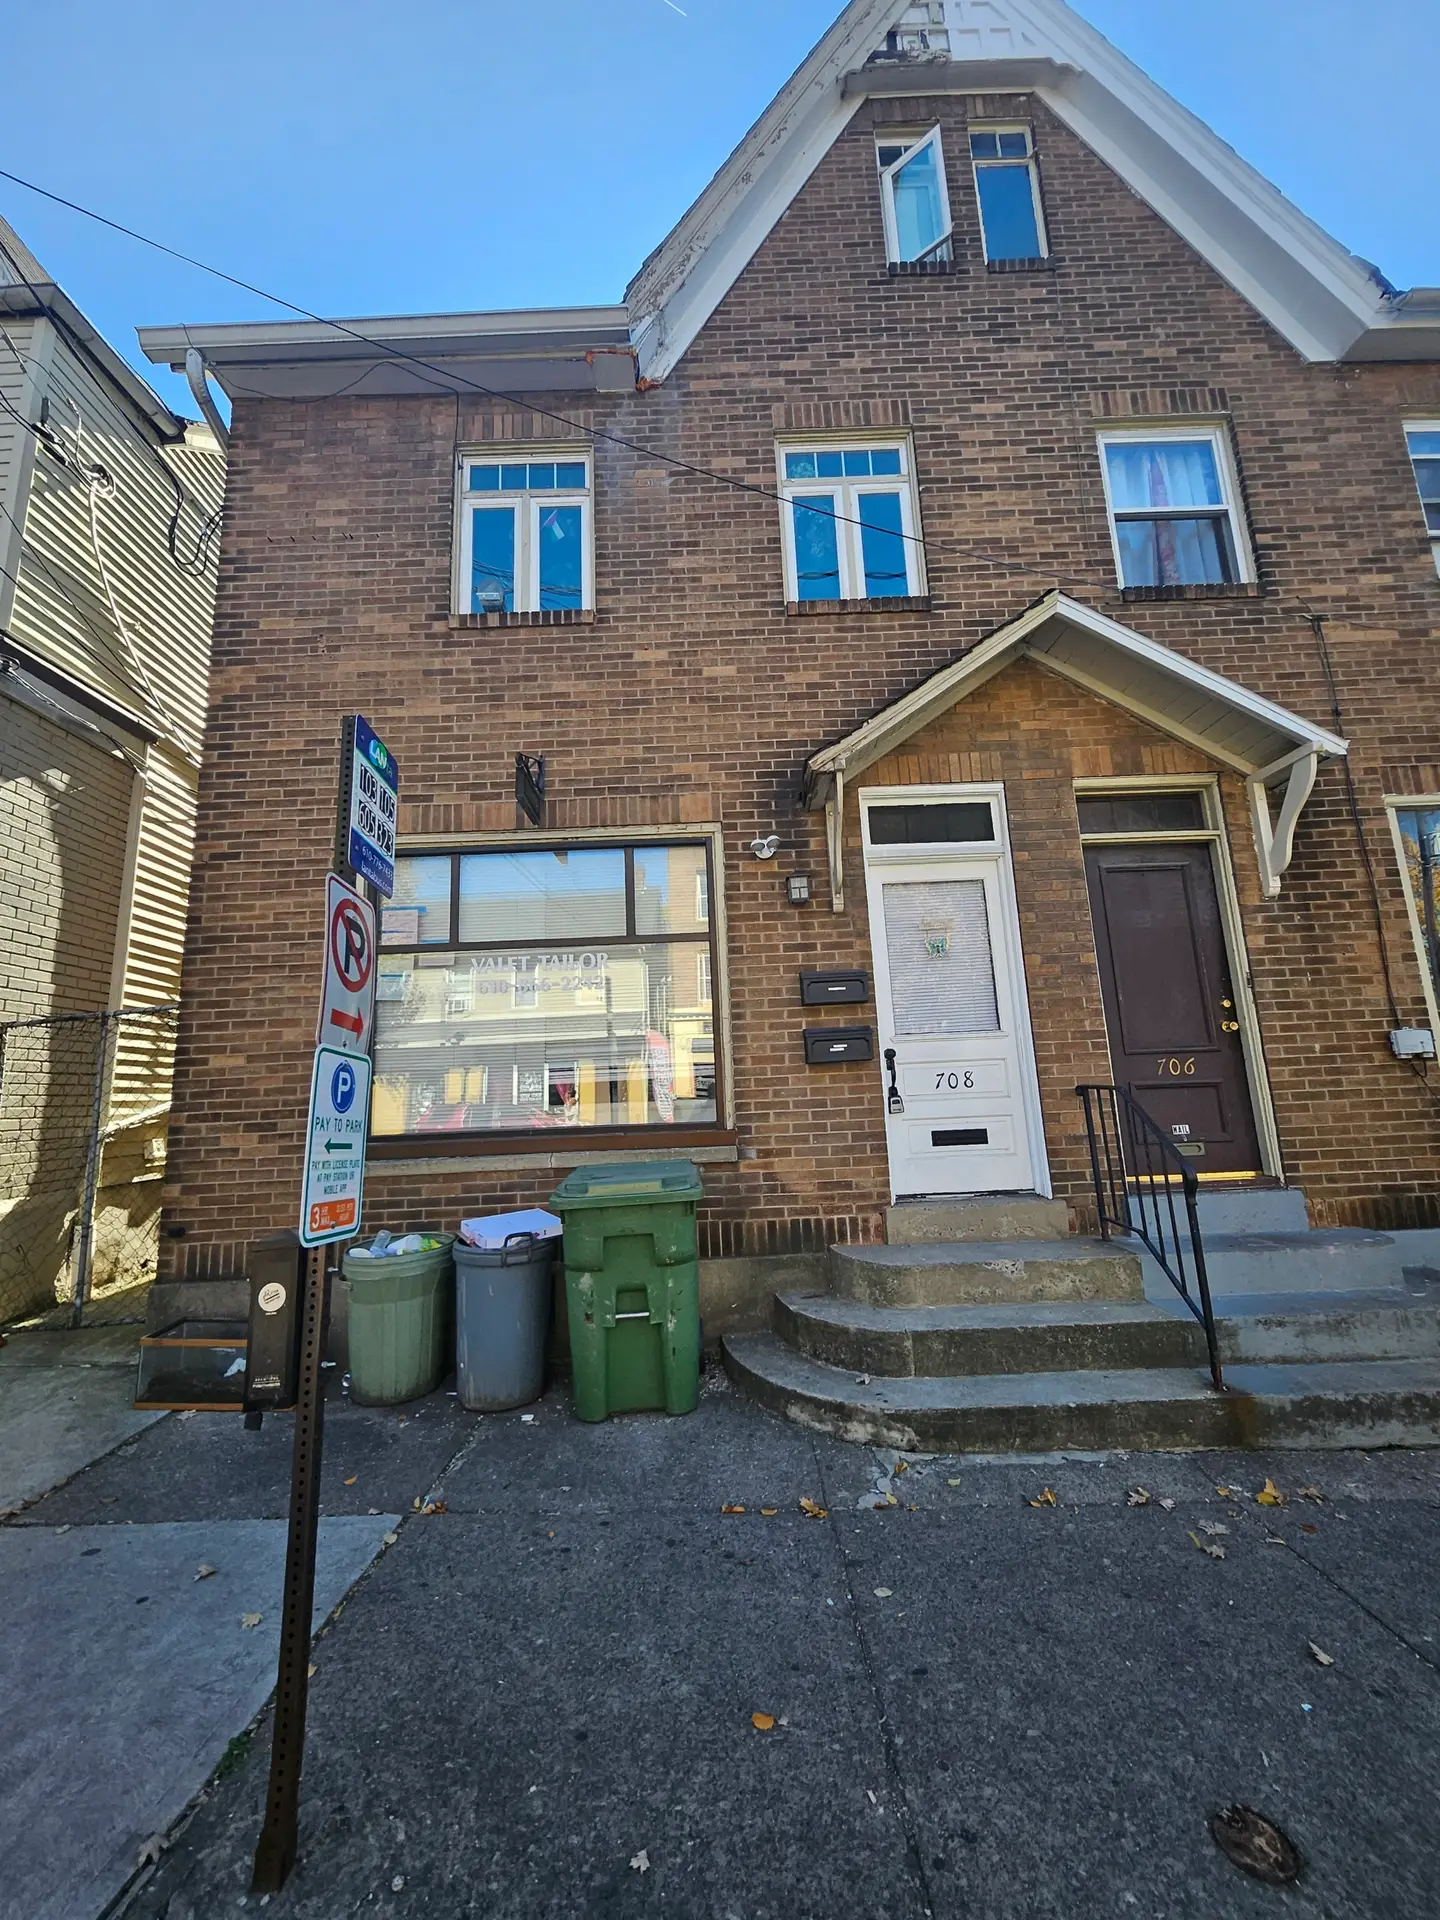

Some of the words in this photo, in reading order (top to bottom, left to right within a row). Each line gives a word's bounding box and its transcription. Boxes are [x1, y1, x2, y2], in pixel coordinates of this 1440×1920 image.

[361, 766, 377, 802] 103
[380, 787, 395, 821] 105
[359, 803, 375, 836] 605
[377, 821, 393, 856] 323
[471, 956, 530, 973] VALET
[538, 952, 610, 971] TAILOR
[1157, 1057, 1195, 1076] 706
[337, 1071, 352, 1104] P
[935, 1070, 974, 1090] 708
[315, 1116, 331, 1132] PAY
[334, 1118, 343, 1132] TO
[345, 1119, 363, 1133] PARK
[1172, 1124, 1189, 1135] MAIL
[311, 1160, 320, 1171] PAY
[322, 1160, 331, 1170] WITH
[317, 1172, 323, 1182] AT
[323, 1172, 332, 1182] PAY
[312, 1206, 320, 1229] 3
